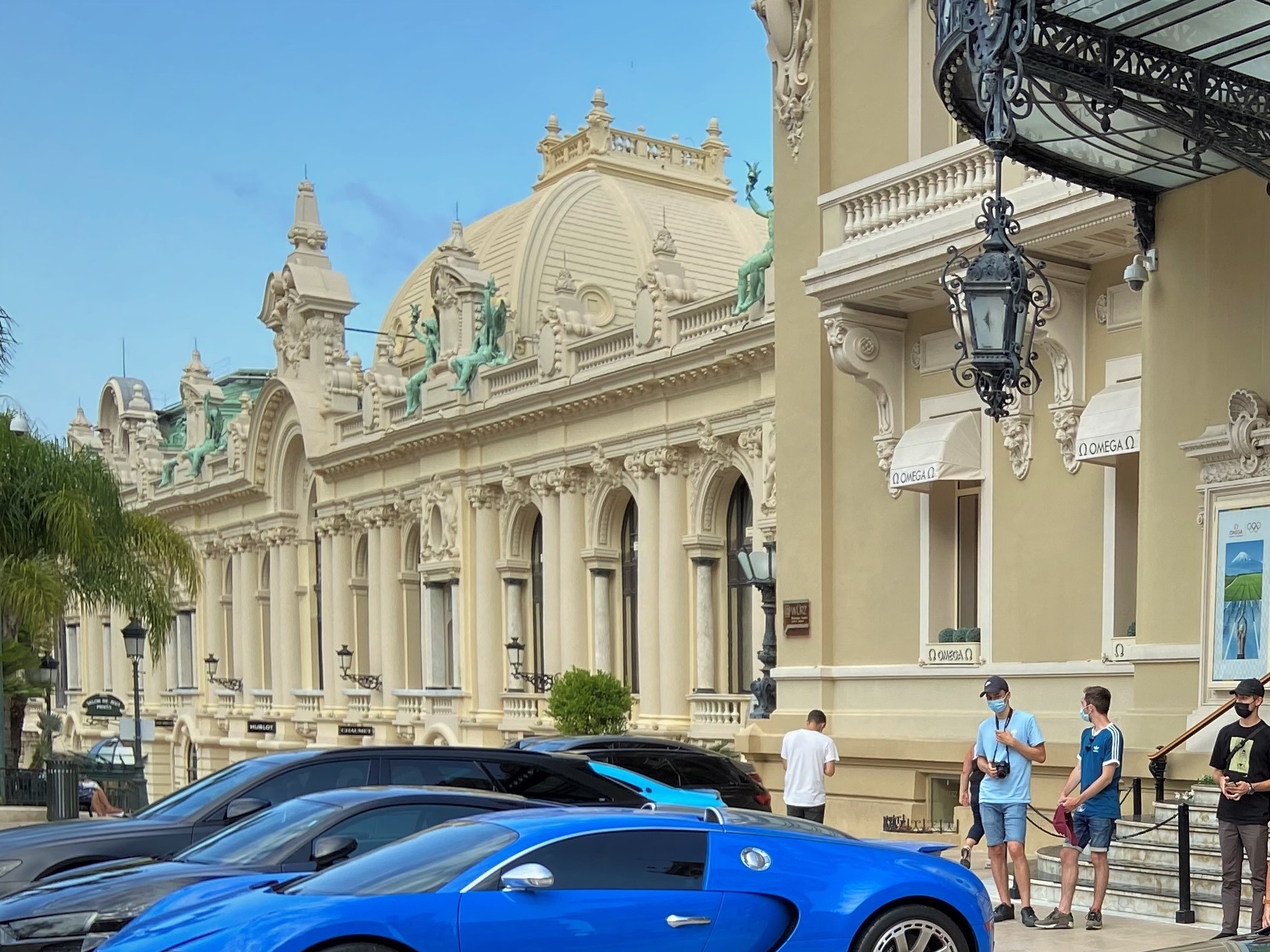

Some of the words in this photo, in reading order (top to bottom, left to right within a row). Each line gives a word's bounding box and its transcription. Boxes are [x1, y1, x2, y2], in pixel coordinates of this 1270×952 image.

[1089, 439, 1123, 455] OMEGA
[900, 470, 926, 484] OMEGA
[938, 650, 963, 661] OMEGA
